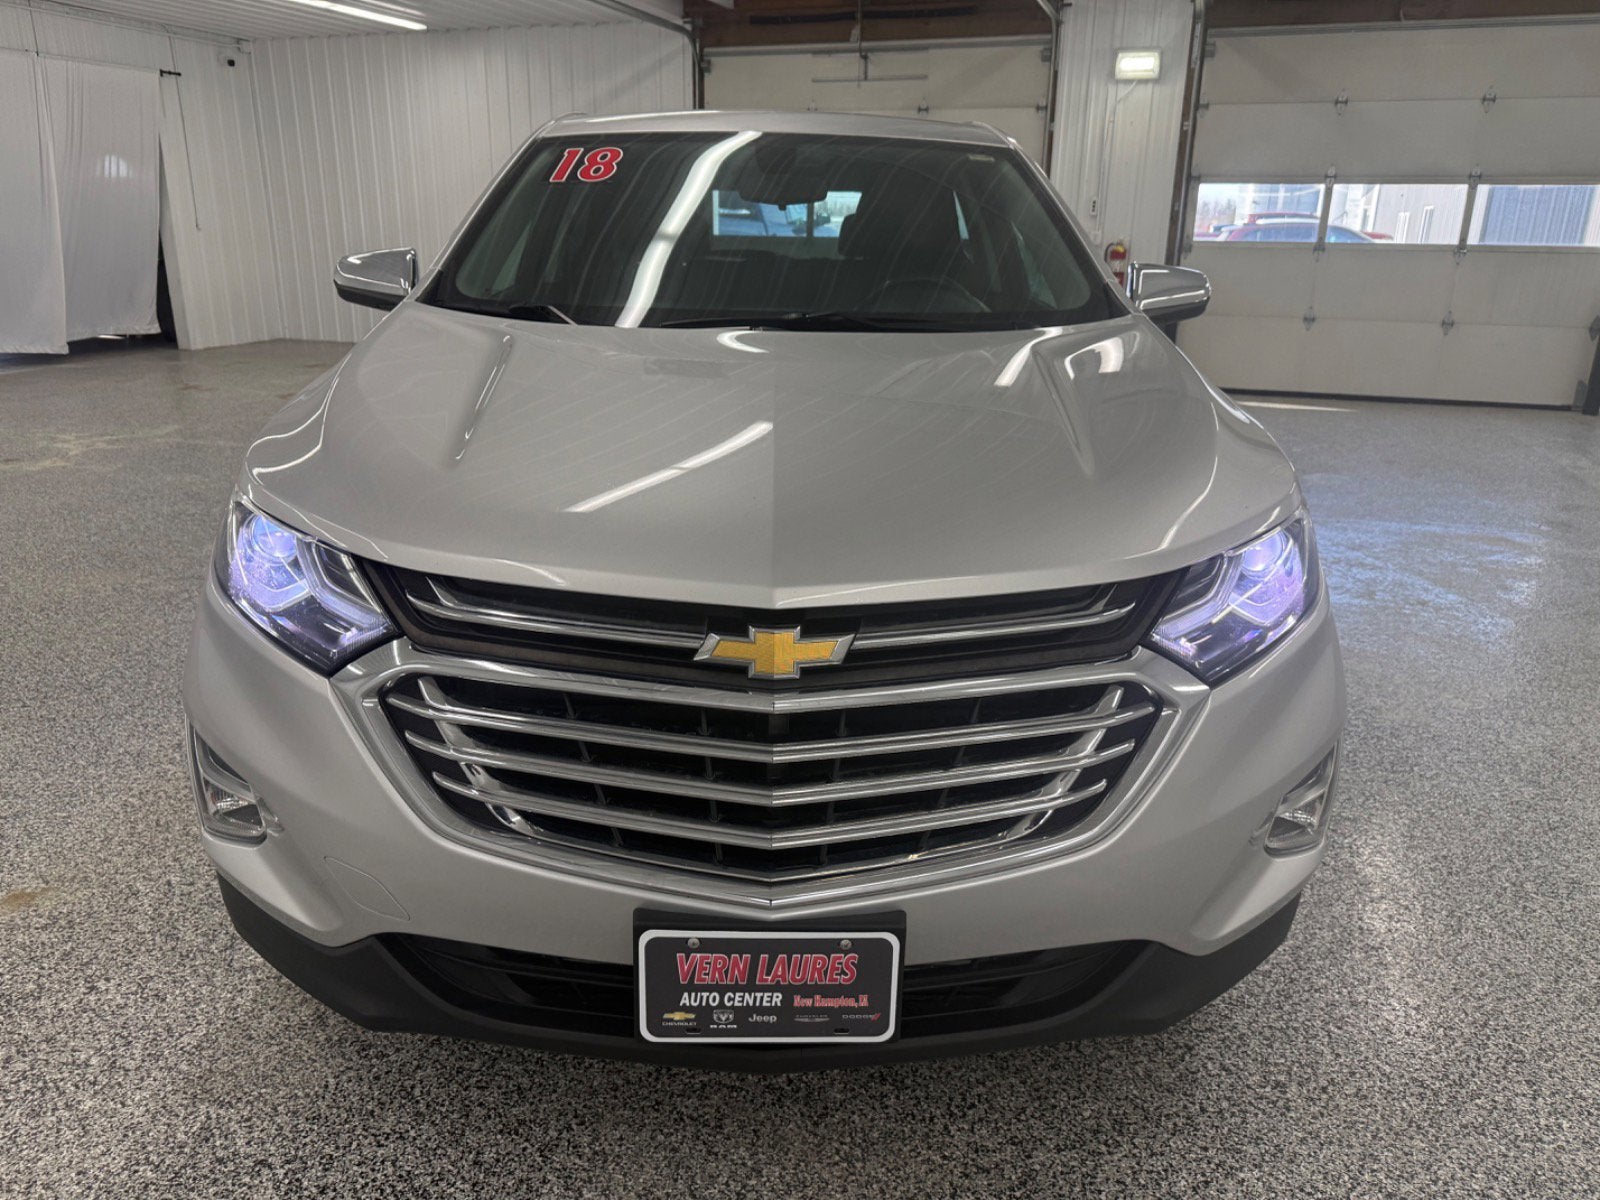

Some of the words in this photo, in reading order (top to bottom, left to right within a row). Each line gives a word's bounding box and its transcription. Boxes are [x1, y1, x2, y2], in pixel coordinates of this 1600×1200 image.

[549, 147, 623, 182] 18
[676, 953, 751, 985] VERN
[756, 953, 859, 985] LAURES
[680, 992, 720, 1007] AUTO
[724, 992, 783, 1007] CENTER
[793, 995, 813, 1007] New
[748, 1013, 777, 1024] Jeep
